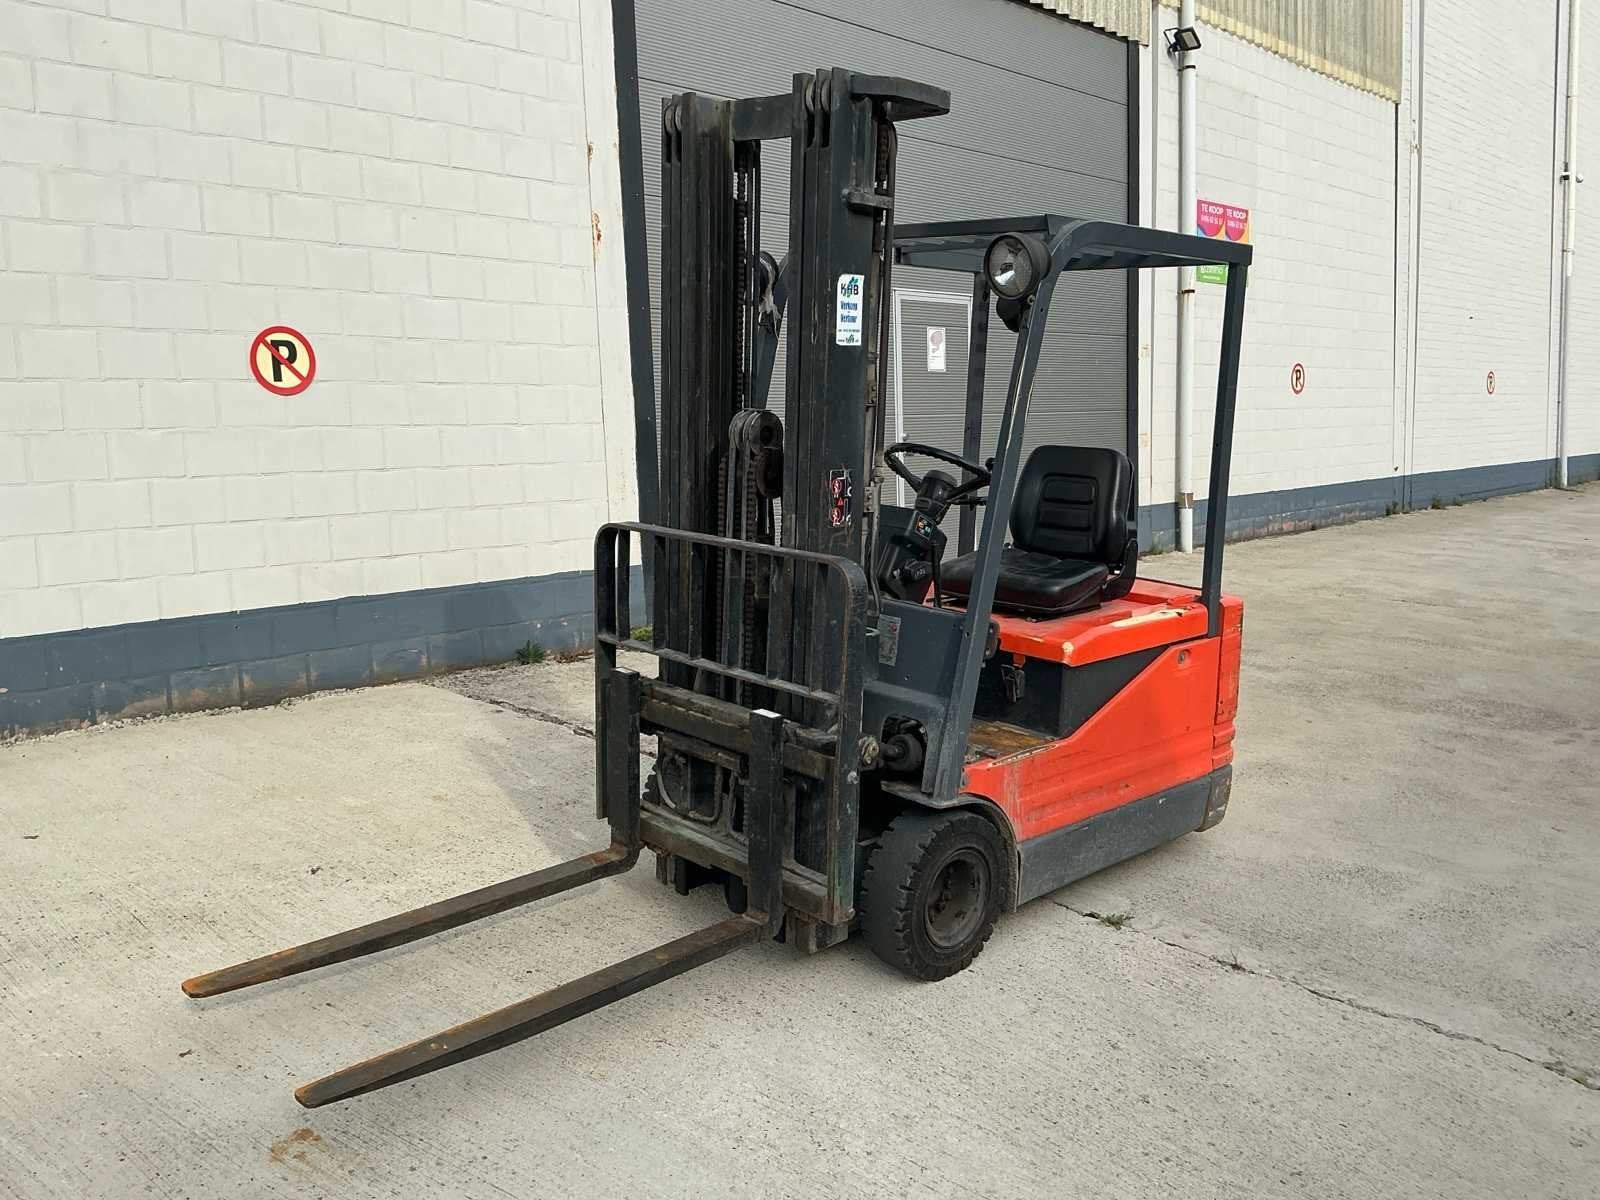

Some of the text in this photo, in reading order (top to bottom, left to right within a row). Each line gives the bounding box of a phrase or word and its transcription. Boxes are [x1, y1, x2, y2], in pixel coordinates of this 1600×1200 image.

[1201, 204, 1224, 215] TE KOOP
[1226, 208, 1246, 219] TE KOOP
[270, 340, 297, 382] P
